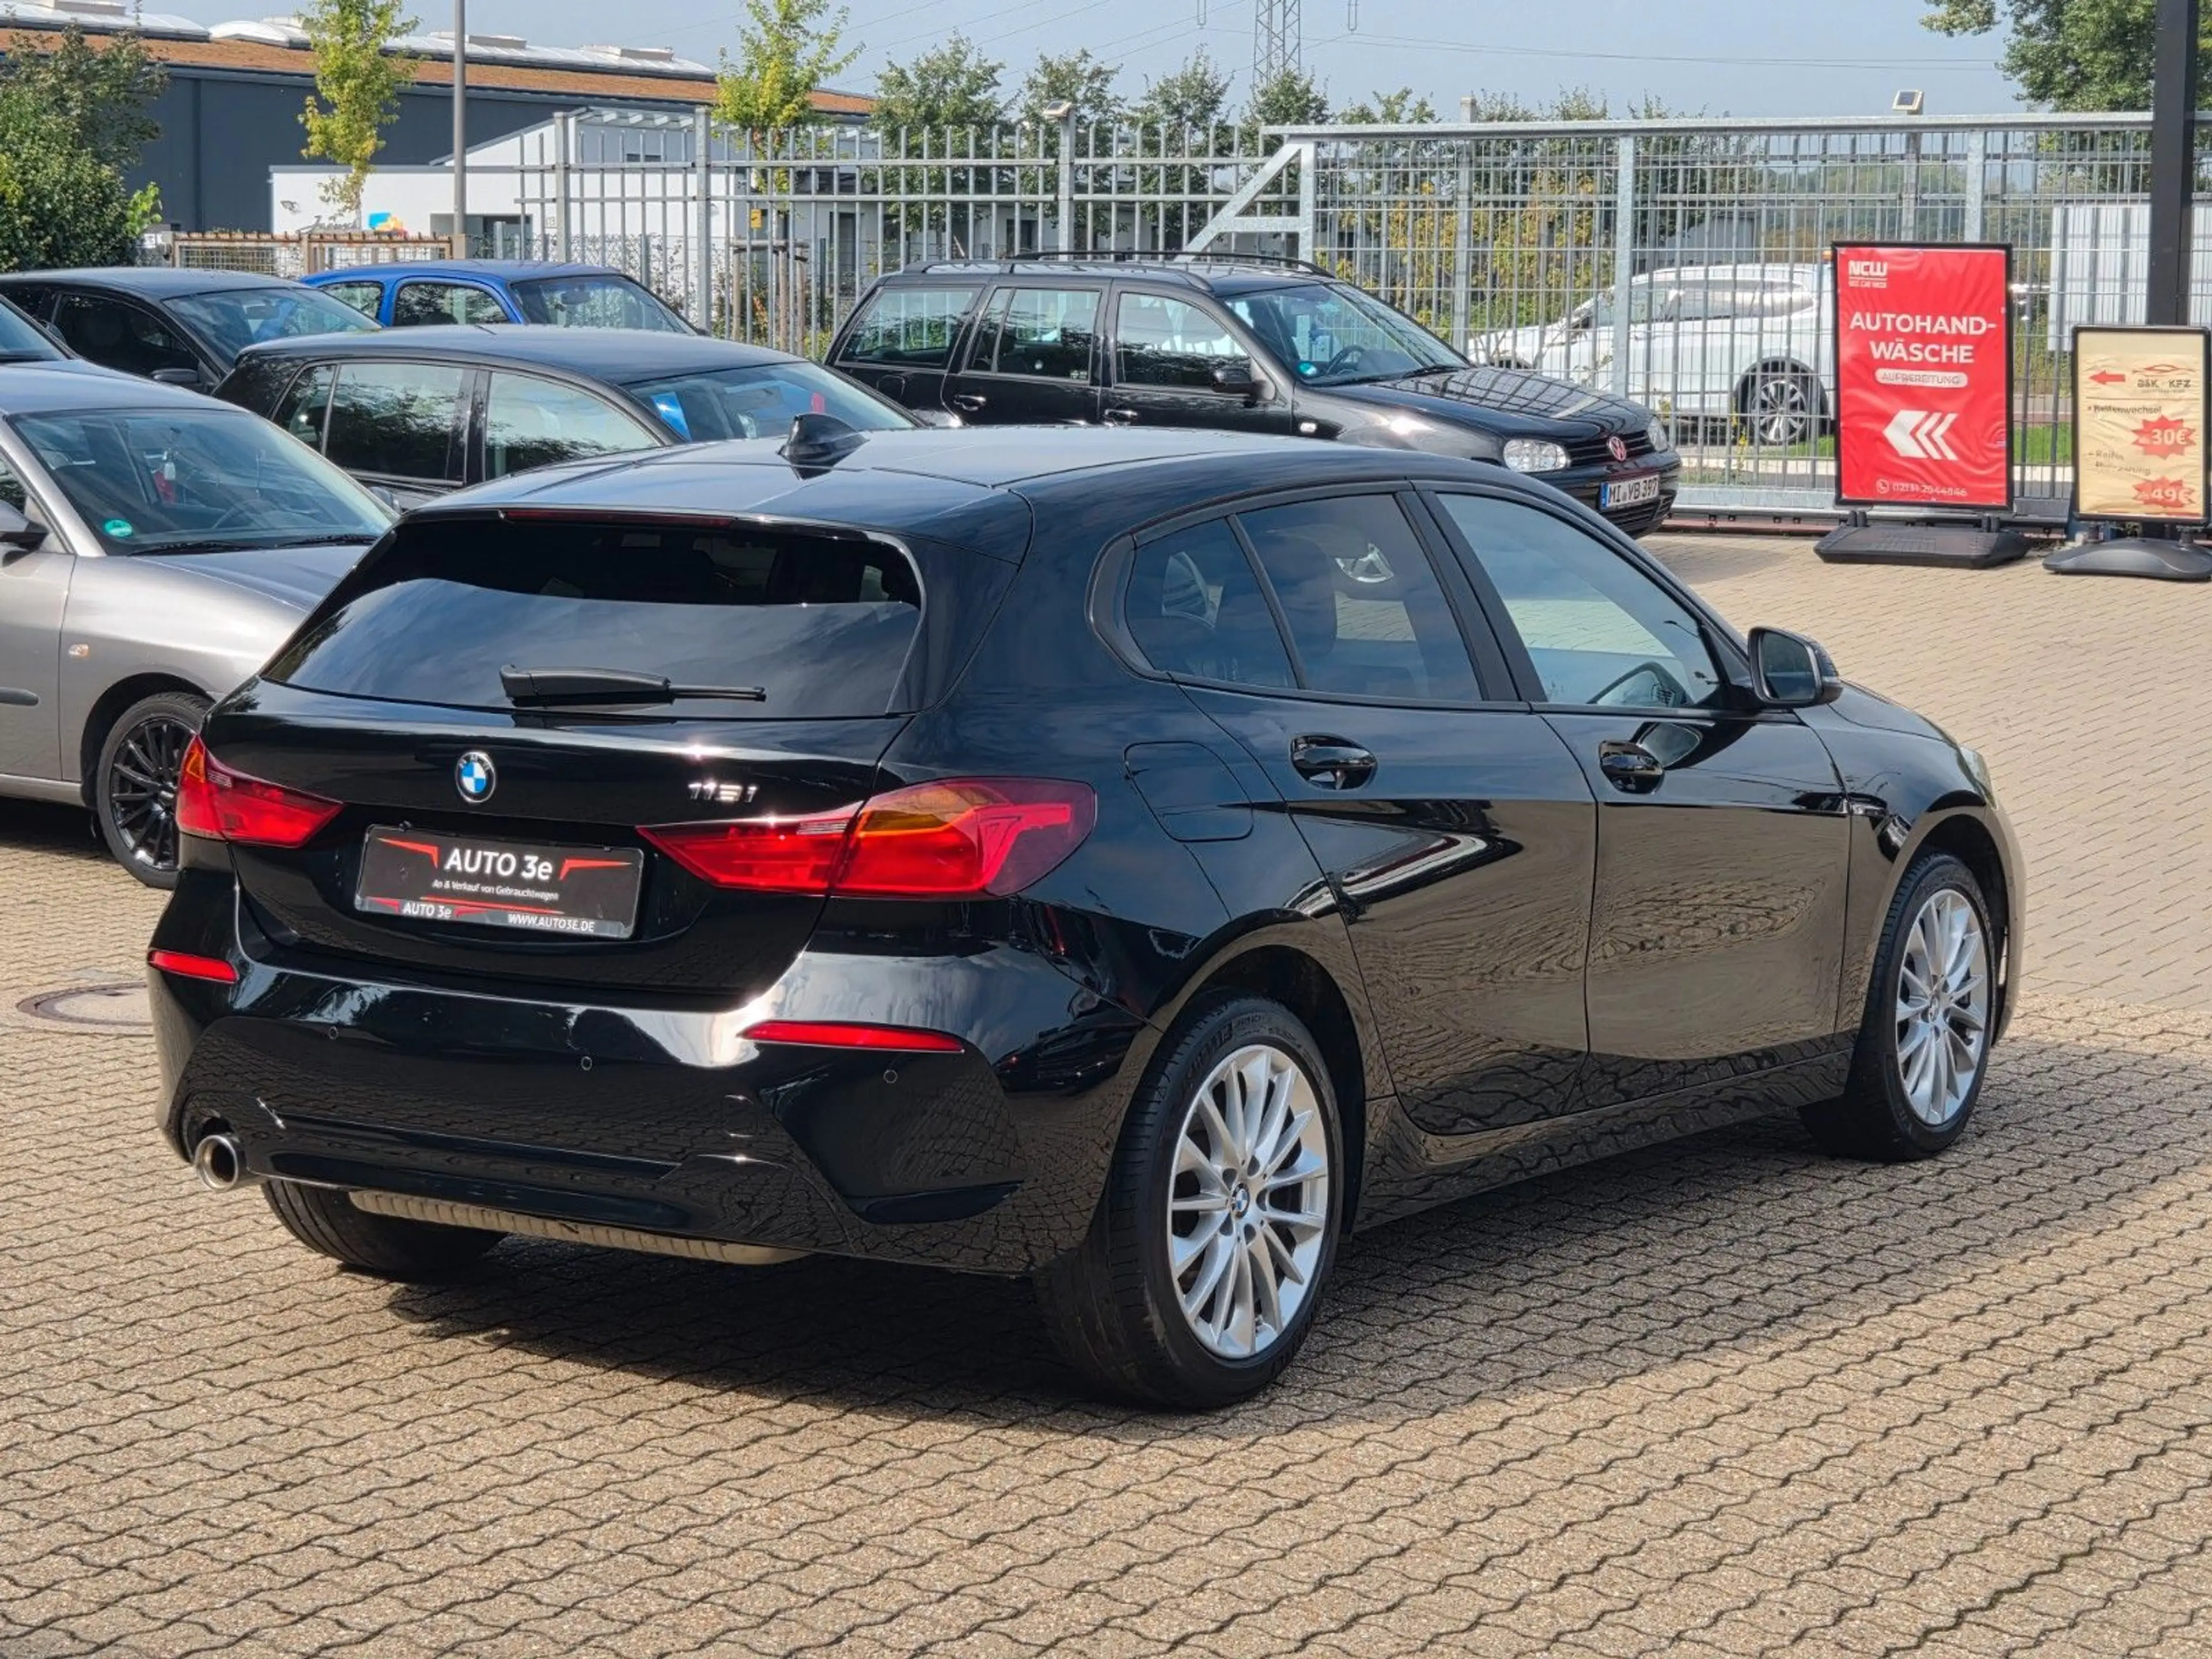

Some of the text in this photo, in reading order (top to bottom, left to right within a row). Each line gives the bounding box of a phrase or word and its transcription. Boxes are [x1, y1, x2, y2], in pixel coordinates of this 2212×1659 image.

[1849, 260, 1888, 276] NCW
[1849, 311, 1997, 335] AUTOHAND-
[1869, 338, 1975, 363] WÄSCHE
[1882, 372, 1960, 385] AUFBEREITUNG
[2152, 428, 2188, 445] 30€
[1628, 482, 1641, 501] YB
[444, 847, 553, 881] AUTO 3e
[432, 879, 443, 888] An
[451, 881, 480, 892] Verkauf
[495, 886, 559, 903] Gebrauchtwagen
[403, 903, 452, 918] AUTO 3e
